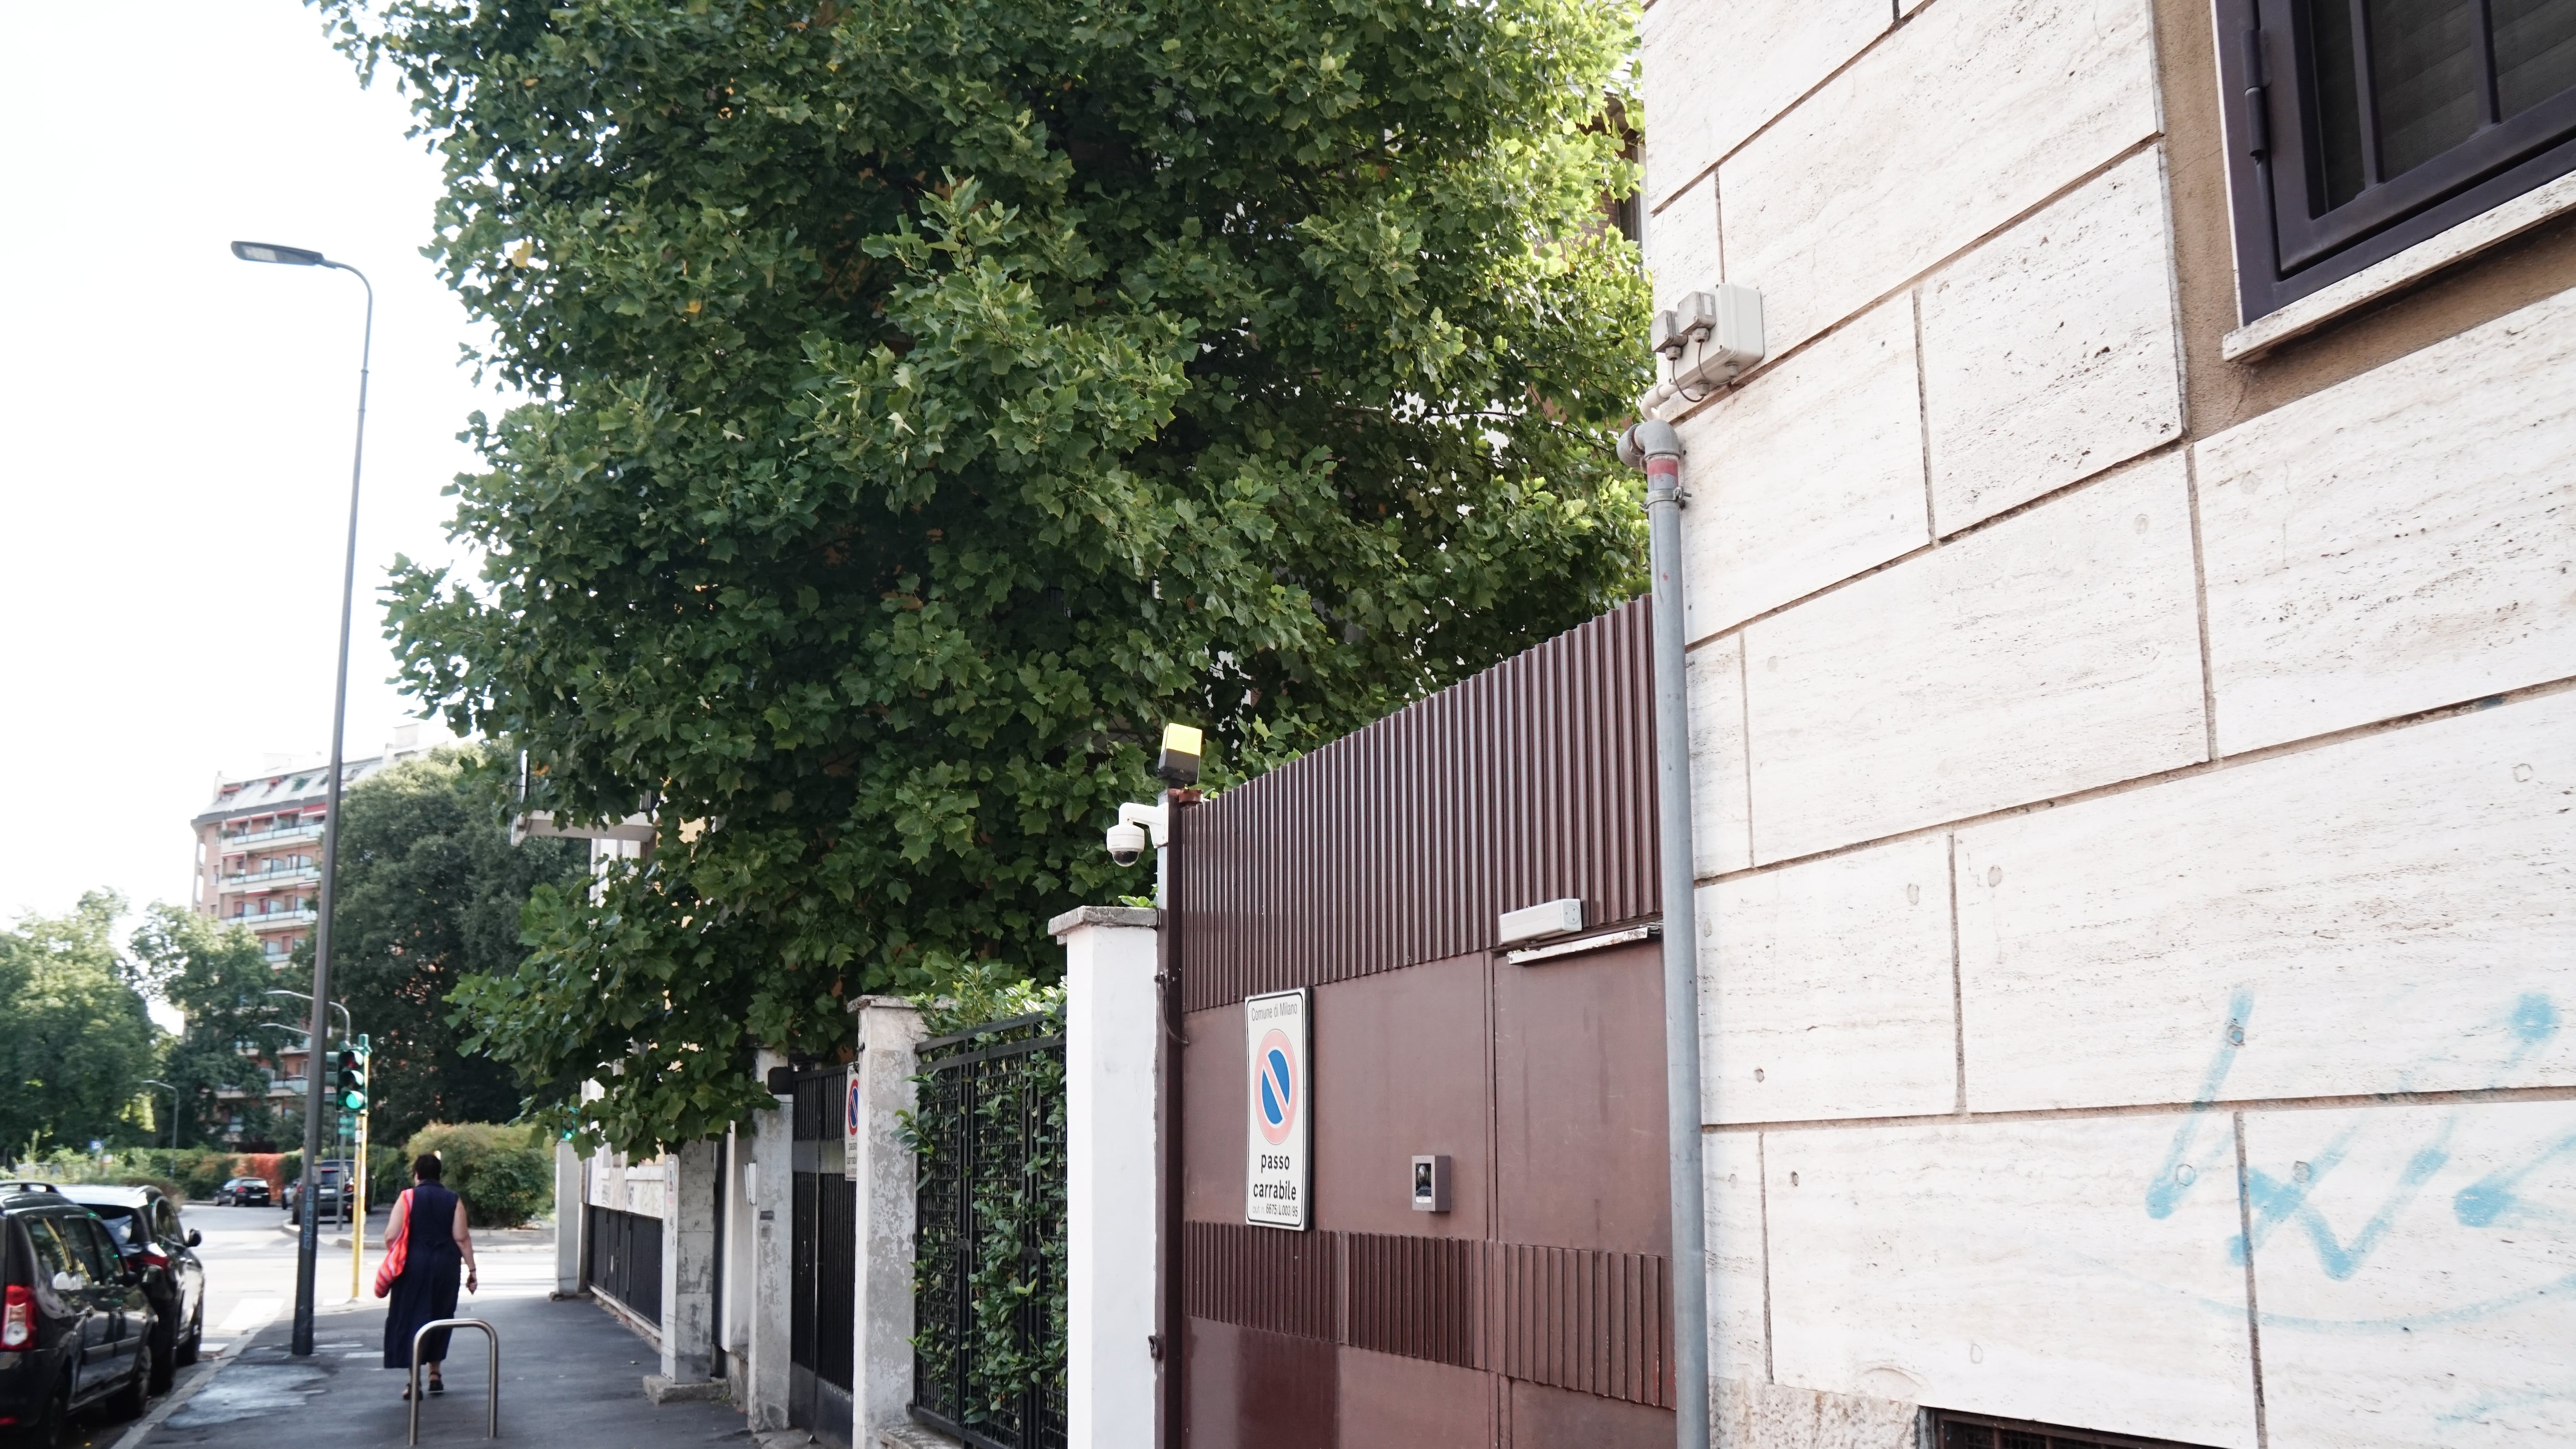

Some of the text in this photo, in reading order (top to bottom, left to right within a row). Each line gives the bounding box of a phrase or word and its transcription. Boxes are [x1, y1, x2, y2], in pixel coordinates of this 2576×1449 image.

[1251, 1001, 1298, 1021] Comune di Milano
[1261, 1153, 1290, 1174] passo
[1253, 1179, 1297, 1201] carrabile
